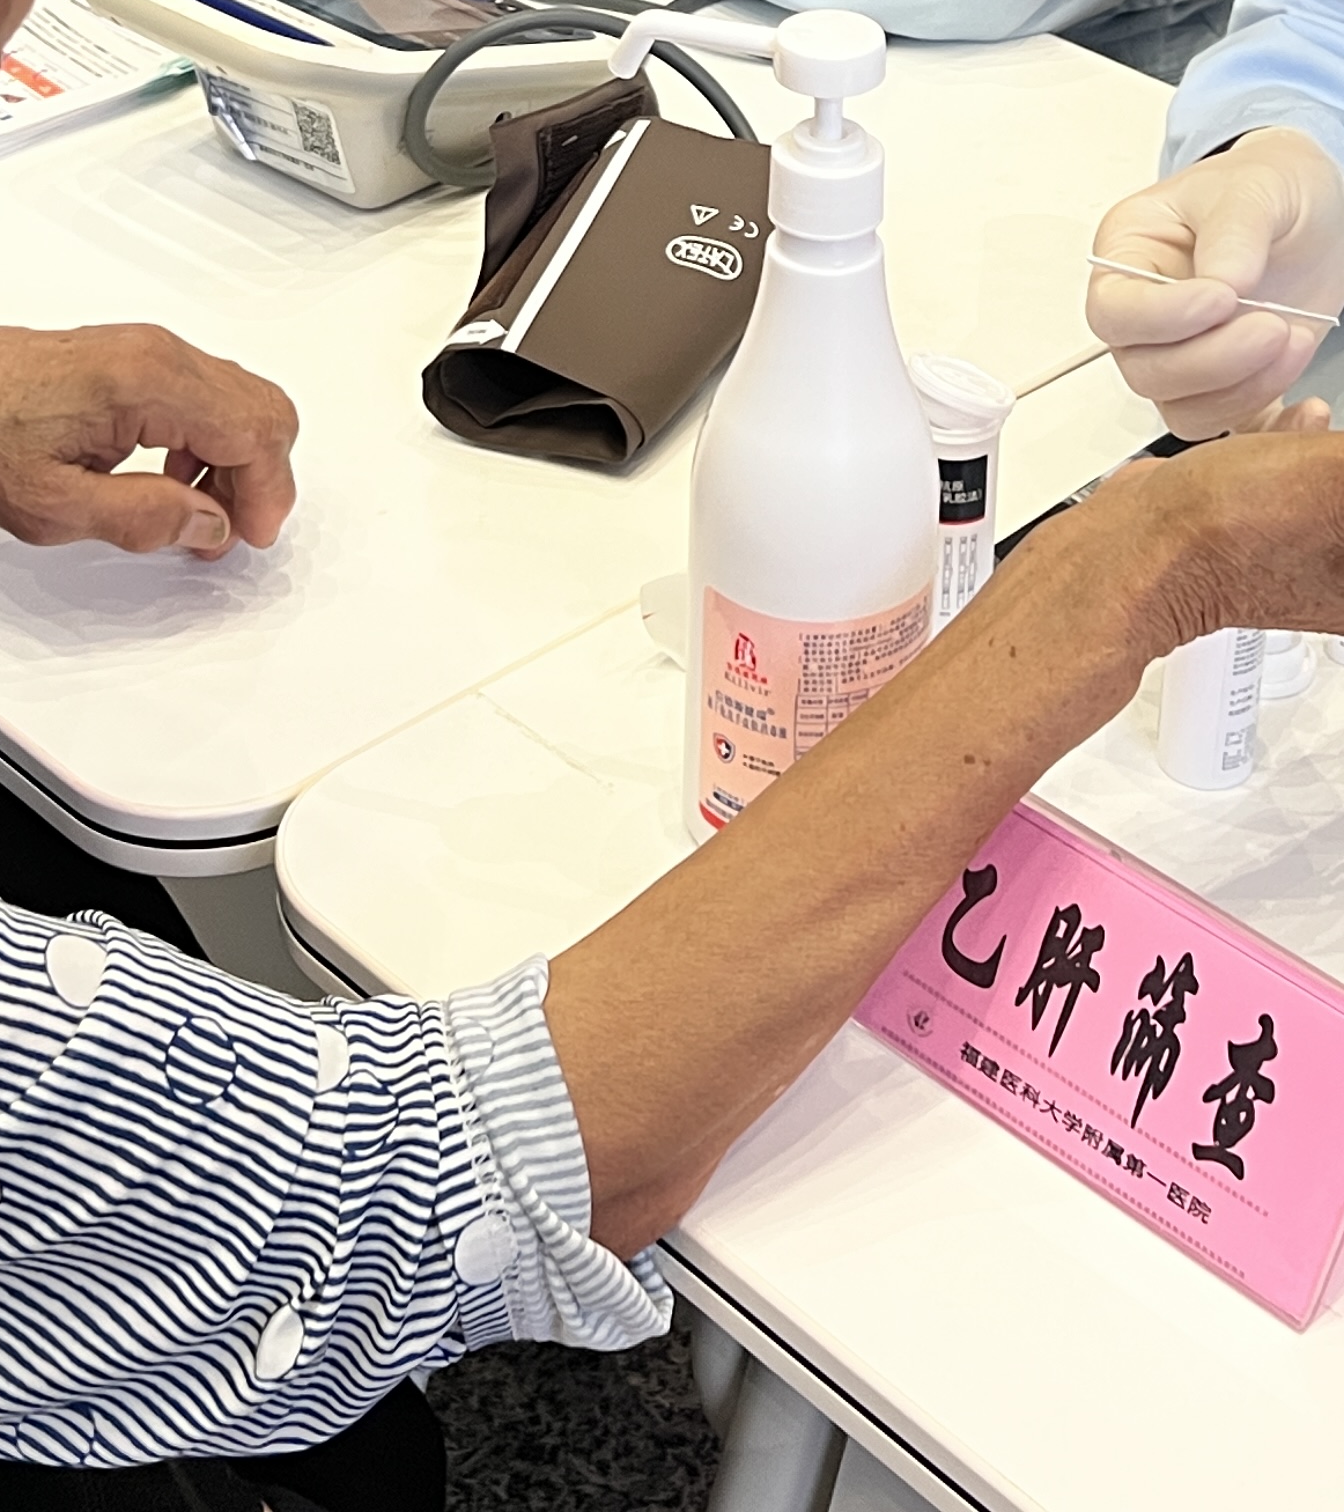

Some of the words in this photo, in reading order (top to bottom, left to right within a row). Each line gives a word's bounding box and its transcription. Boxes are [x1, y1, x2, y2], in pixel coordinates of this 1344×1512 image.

[941, 864, 1278, 1181] 乙肝筛查
[959, 1041, 1213, 1225] 福建医科大学附属第一医院
